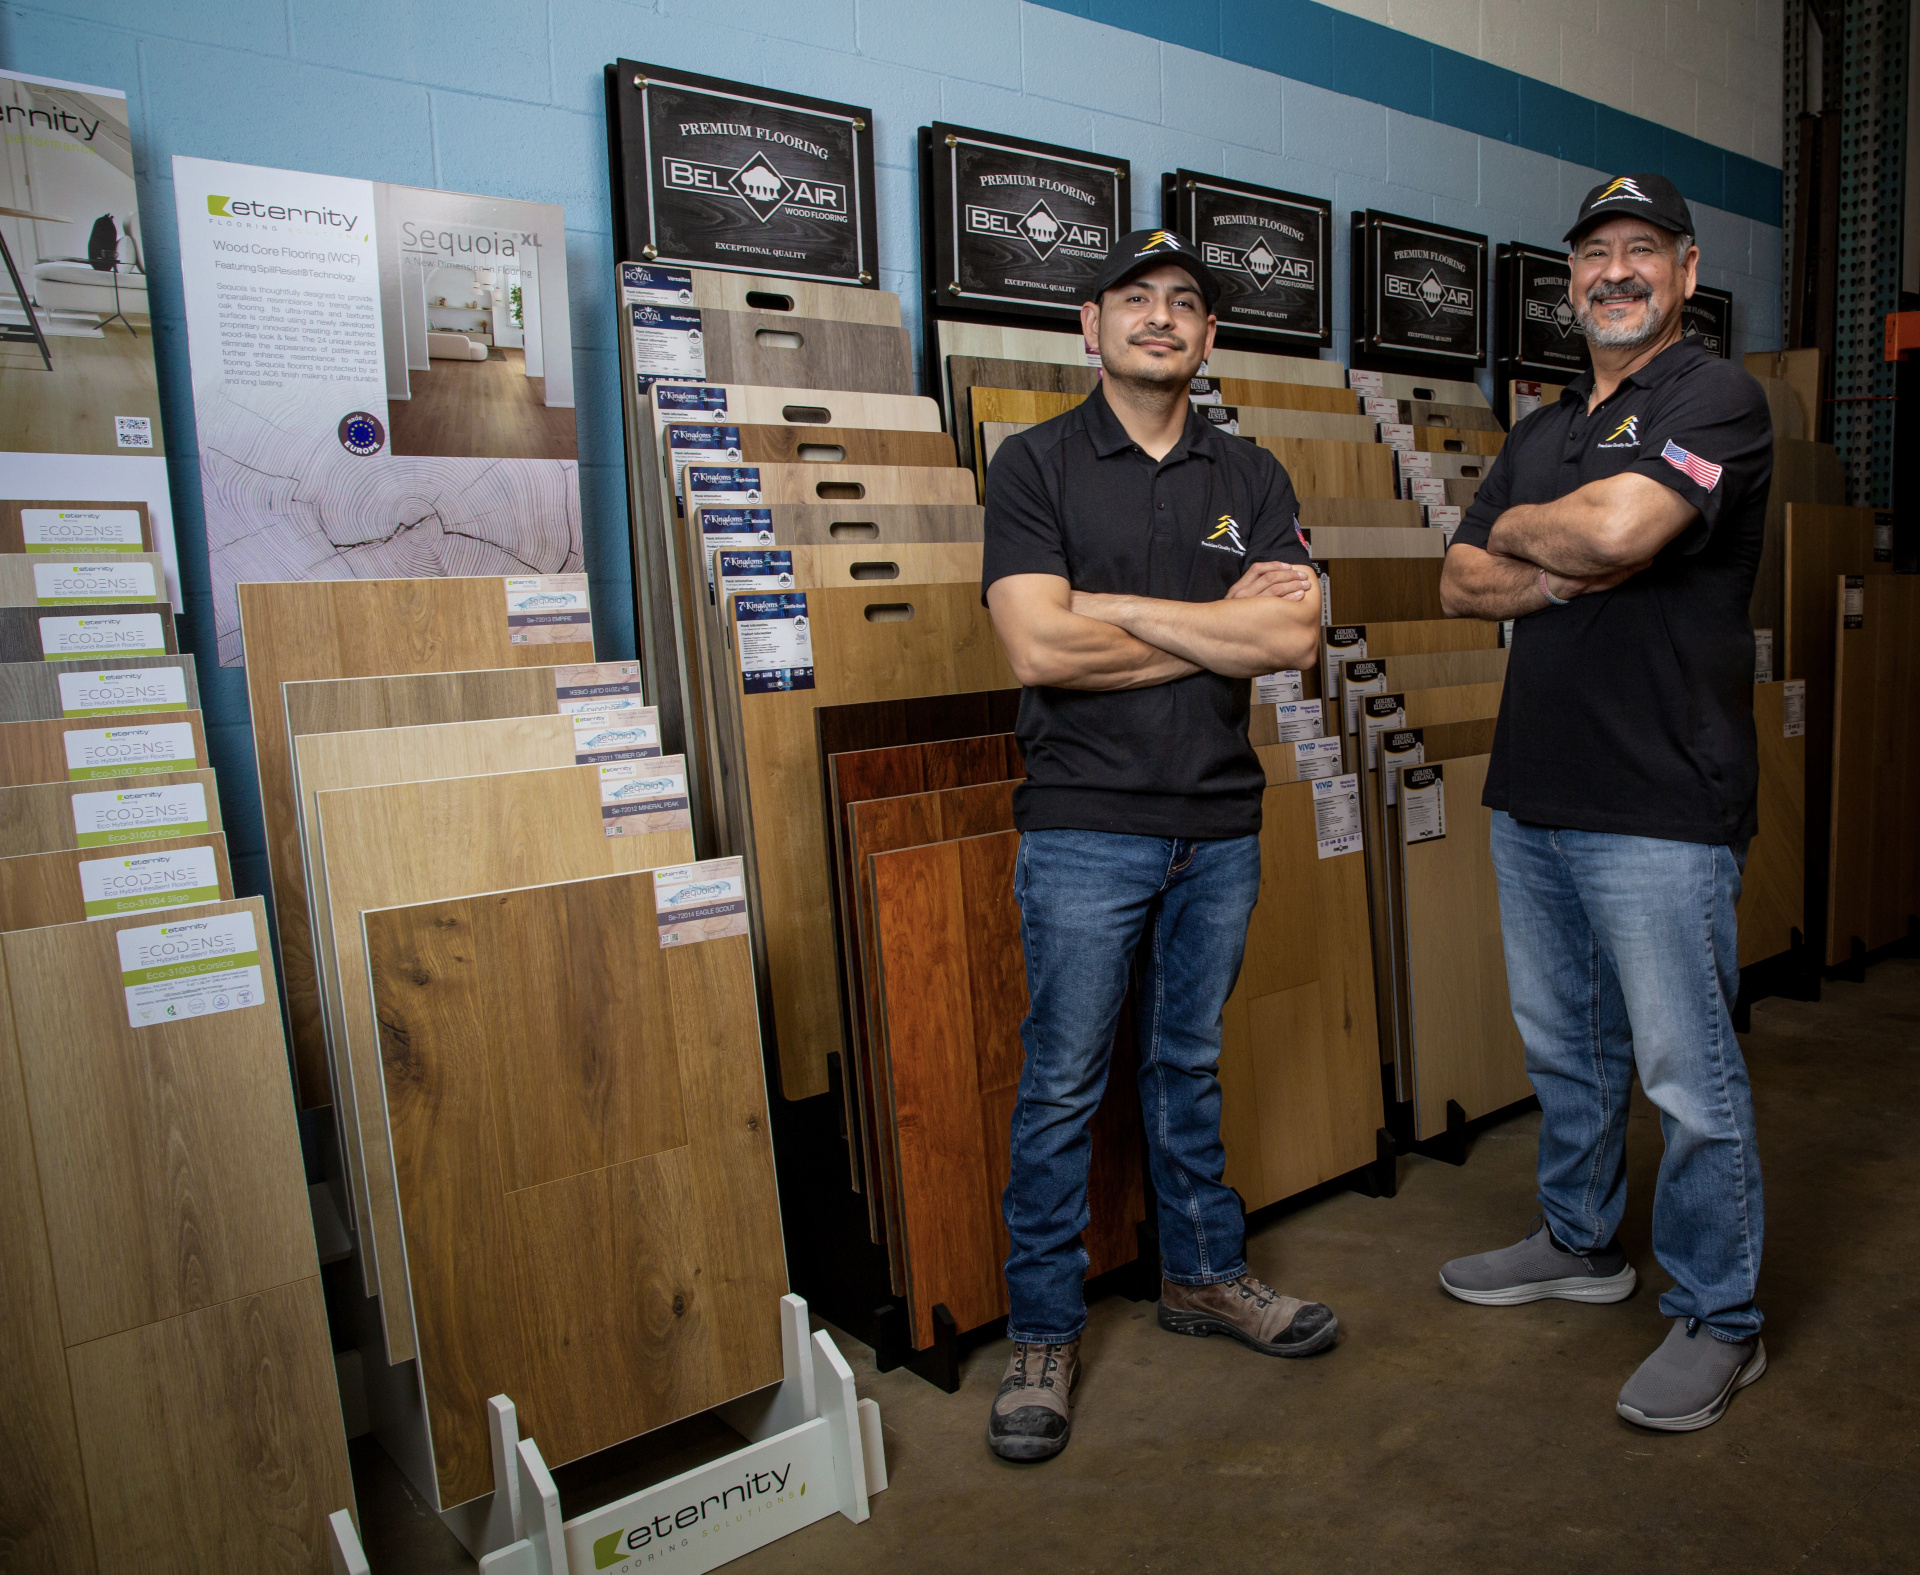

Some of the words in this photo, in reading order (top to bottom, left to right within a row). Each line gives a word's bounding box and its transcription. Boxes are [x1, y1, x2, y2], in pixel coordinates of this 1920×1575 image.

[0, 105, 100, 141] rnity
[5, 132, 97, 155] performance
[679, 122, 752, 138] PREMIUM
[755, 127, 829, 161] FLOORING
[670, 162, 730, 191] BEL
[793, 182, 838, 207] AIR
[979, 174, 1036, 187] PREMIUM
[1038, 177, 1096, 206] FLOORING
[231, 200, 357, 231] eternity
[784, 207, 810, 218] WOOD
[811, 211, 848, 223] FLOORING
[209, 218, 277, 232] FLOORING
[288, 227, 360, 240] SOLUTIONS
[972, 209, 1017, 234] BEL
[1067, 225, 1101, 247] AIR
[1212, 214, 1258, 226] PREMIUM
[1259, 217, 1304, 242] FLOORING
[520, 232, 542, 247] XL
[213, 239, 248, 253] Wood
[251, 243, 279, 256] Core
[281, 247, 325, 263] Flooring
[327, 251, 360, 266] (WCF)
[715, 241, 771, 255] EXCEPTIONAL
[772, 249, 806, 260] QUALITY
[1060, 247, 1080, 257] WOOD
[404, 257, 411, 265] A
[413, 257, 433, 267] New
[437, 259, 483, 272] Dimension
[497, 265, 532, 278] Flooring
[1206, 246, 1242, 268] BEL
[1281, 259, 1308, 278] AIR
[1393, 249, 1429, 260] PREMIUM
[1430, 251, 1466, 273] FLOORING
[215, 260, 256, 273] Featuring
[308, 269, 356, 283] Technology
[624, 271, 654, 282] ROYAL
[1004, 278, 1049, 289] EXCEPTIONAL
[1049, 284, 1076, 293] QUALITY
[1274, 278, 1290, 287] WOOD
[1291, 281, 1315, 291] FLOORING
[1533, 276, 1563, 287] PREMIUM
[216, 282, 247, 292] Sequoia
[259, 286, 300, 297] thoughtfully
[303, 290, 336, 300] designed
[347, 293, 373, 303] provide
[1388, 277, 1417, 297] BEL
[1447, 289, 1469, 306] AIR
[217, 293, 262, 303] unparalleled
[266, 297, 313, 306] resemblance
[329, 301, 351, 311] trendy
[355, 303, 373, 311] white
[634, 311, 664, 322] ROYAL
[1231, 306, 1266, 316] EXCEPTIONAL
[1266, 311, 1288, 319] QUALITY
[1528, 302, 1552, 320] BEL
[1191, 383, 1211, 391] LUSTER
[667, 391, 698, 402] Kingdoms
[347, 414, 363, 424] made
[366, 416, 375, 425] in
[680, 430, 711, 442] Kingdoms
[344, 440, 380, 454] EUROPE
[700, 472, 731, 484] Kingdoms
[711, 514, 743, 526] Kingdoms
[39, 525, 122, 536] ECODENSE
[731, 556, 763, 568] Kingdoms
[53, 578, 137, 590] ECODENSE
[745, 601, 778, 612] Kingdoms
[58, 630, 144, 645] ECODENSE
[1334, 633, 1358, 641] ELEGANCE
[1356, 662, 1376, 670] GOLDEN
[79, 684, 166, 701] ECODENSE
[1373, 702, 1397, 710] ELEGANCE
[111, 729, 150, 737] eternity
[1394, 732, 1413, 740] GOLDEN
[1392, 737, 1416, 746] ELEGANCE
[84, 740, 174, 759] ECODENSE
[588, 754, 613, 763] Se-72011
[614, 752, 635, 760] TIMBER
[91, 767, 138, 778] Eco-31007
[140, 765, 174, 774] Seneca
[1412, 773, 1435, 782] ELEGANCE
[1413, 768, 1433, 776] GOLDEN
[123, 791, 163, 800] eternity
[96, 802, 187, 823] ECODENSE
[611, 806, 638, 815] Se-72012
[638, 802, 663, 811] MINERAL
[108, 830, 156, 842] Eco-31002
[158, 829, 181, 838] Knox
[131, 856, 171, 866] eternity
[102, 867, 197, 890] ECODENSE
[120, 887, 142, 896] Hybrid
[143, 884, 170, 892] Resilient
[171, 880, 197, 889] Flooring
[679, 886, 716, 898] Sequoia
[117, 897, 165, 910] Eco-31004
[168, 894, 189, 904] Sligo
[668, 911, 694, 921] Se-72014
[695, 907, 715, 917] EAGLE
[715, 904, 735, 912] SCOUT
[167, 922, 208, 933] eternity
[138, 933, 234, 959] ECODENSE
[156, 956, 179, 964] Hybrid
[180, 951, 208, 960] Resilient
[209, 946, 236, 955] Flooring
[146, 965, 196, 980] Eco-31003
[198, 960, 234, 971] Corsica
[626, 1462, 791, 1550] eternity
[701, 1491, 795, 1538] SOLUTIONS
